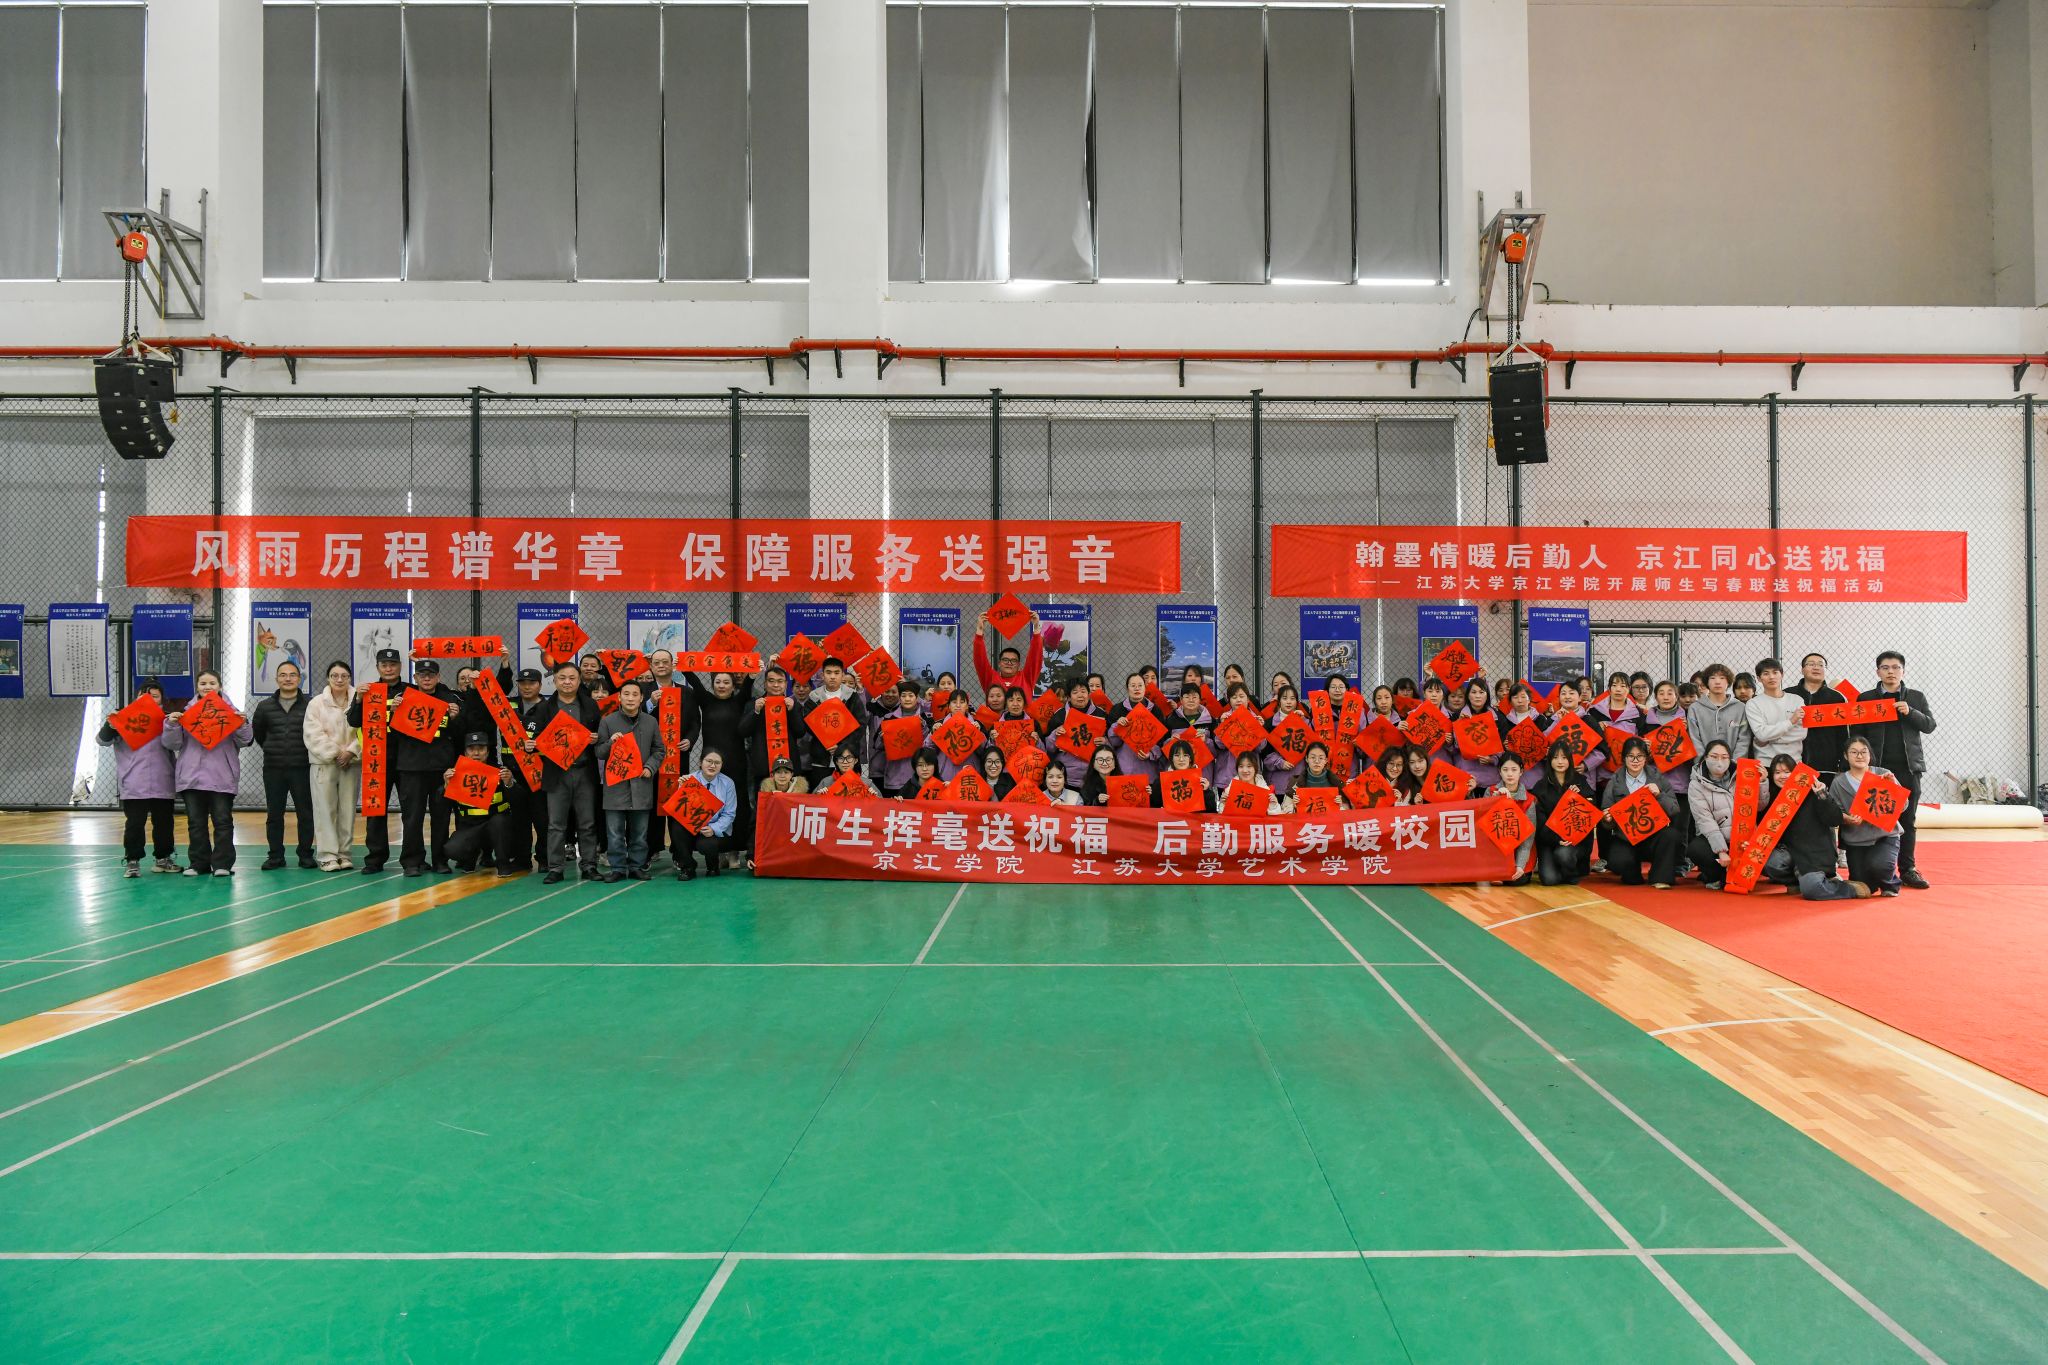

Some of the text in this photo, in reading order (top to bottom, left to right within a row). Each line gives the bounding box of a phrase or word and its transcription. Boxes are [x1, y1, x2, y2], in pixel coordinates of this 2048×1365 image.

[191, 530, 1115, 584] 风雨历程谱华章 保障服务送强音
[1355, 541, 1885, 572] 翰墨情暖后勤人 京江同心送祝福
[1070, 723, 1093, 748] 福
[1281, 727, 1307, 754] 福
[1170, 777, 1193, 803] 福
[1433, 772, 1456, 793] 福
[1233, 790, 1255, 811] 福
[1305, 796, 1327, 816] 福
[1865, 787, 1897, 818] 福
[789, 803, 1476, 855] 师生挥毫送祝福 后勤服务暖校园
[872, 850, 1393, 878] 京江学院 江苏大学艺术学院
